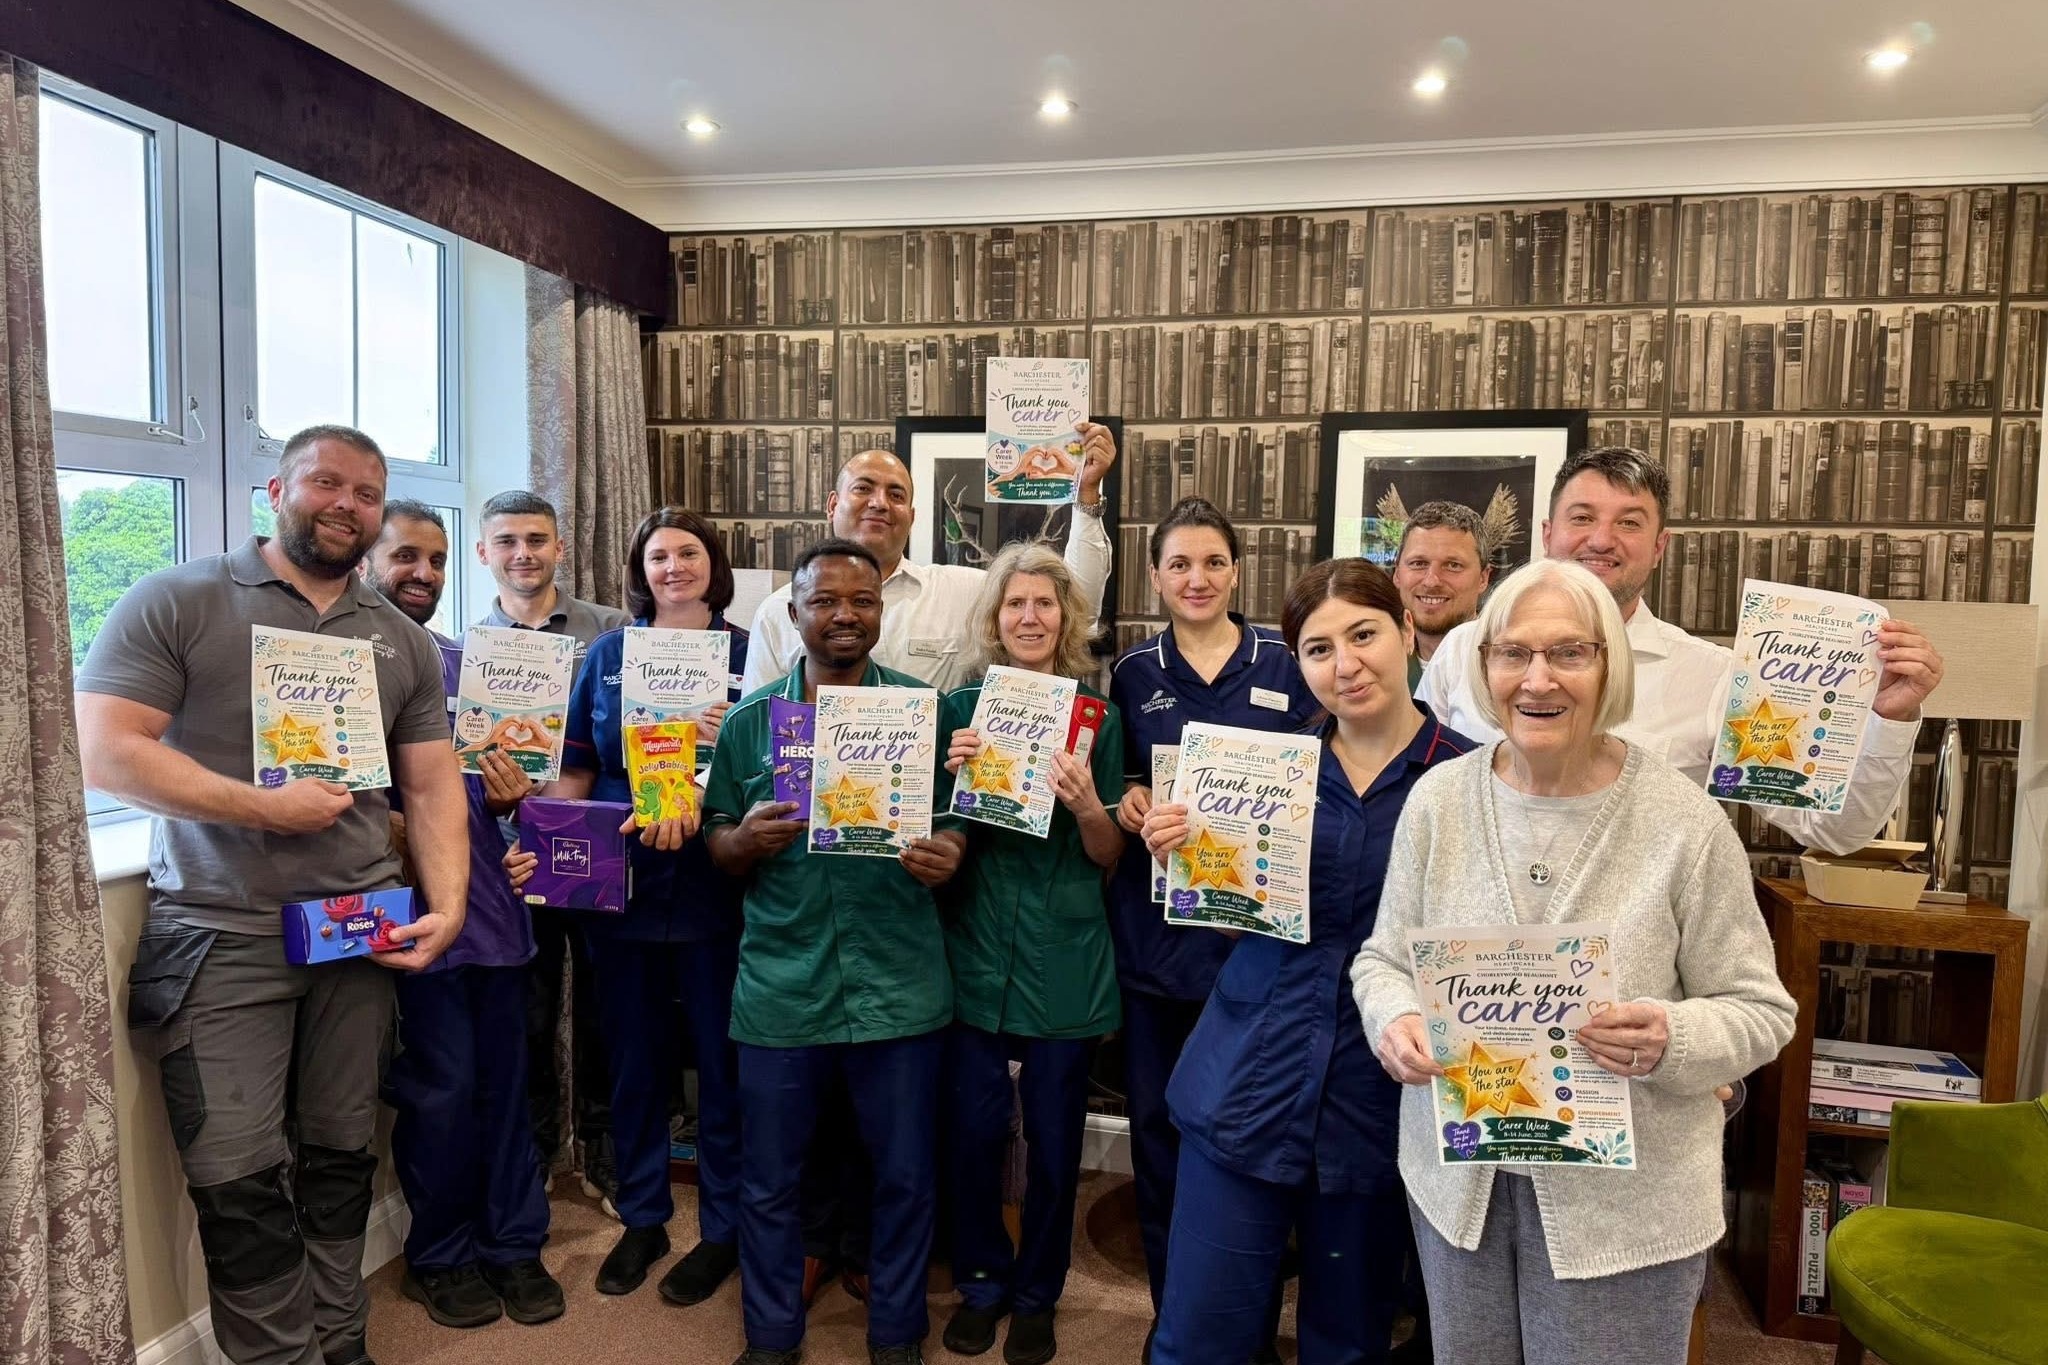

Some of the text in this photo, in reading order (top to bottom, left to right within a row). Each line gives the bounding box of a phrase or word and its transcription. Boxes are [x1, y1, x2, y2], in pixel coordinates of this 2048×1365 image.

[1013, 371, 1062, 379] BARCHESTER
[1001, 394, 1070, 413] Thank you
[1012, 410, 1064, 423] carer
[1017, 488, 1038, 497] Thank
[1792, 613, 1853, 629] BARCHESTER
[493, 640, 545, 651] BARCHESTER
[651, 641, 701, 650] BARCHESTER
[1753, 630, 1866, 667] Thank you
[292, 650, 339, 661] BARCHESTER
[265, 663, 320, 686] Thank
[326, 675, 358, 691] you
[477, 661, 552, 682] Thank you
[637, 662, 709, 681] Thank you
[1760, 657, 1856, 687] carer
[487, 678, 545, 693] carer
[648, 678, 702, 691] carer
[276, 683, 354, 702] carer
[1010, 686, 1050, 699] BARCHESTER
[986, 697, 1058, 727] Thank you
[986, 716, 1053, 740] carer
[1749, 720, 1787, 734] You are
[280, 729, 298, 740] You
[828, 722, 920, 747] Thank you
[1750, 732, 1787, 743] the star
[285, 738, 313, 747] the star
[642, 738, 682, 753] Maynards
[780, 745, 816, 759] HERO
[837, 742, 915, 762] carer
[1223, 751, 1277, 765] BARCHESTER
[299, 765, 334, 773] Carer Week
[980, 761, 993, 771] You
[980, 768, 991, 777] the
[1756, 768, 1795, 781] Carer Week
[1192, 767, 1296, 802] Thank you
[835, 791, 852, 803] You
[985, 796, 1015, 807] Carer Week
[839, 800, 867, 810] the star
[1198, 791, 1287, 821] carer
[848, 827, 882, 836] Carer Week
[553, 848, 588, 867] Milk Tray
[1196, 847, 1214, 859] You
[1199, 858, 1230, 869] the star
[1211, 892, 1250, 906] Carer Week
[346, 919, 375, 933] Roses
[1475, 952, 1555, 962] BARCHESTER
[1436, 974, 1588, 1005] Thank you
[1457, 999, 1580, 1024] carer
[1468, 1066, 1515, 1082] You are
[1474, 1076, 1518, 1093] the star
[1452, 1127, 1471, 1136] Thank
[1497, 1119, 1551, 1131] Carer Week
[1453, 1135, 1469, 1143] you for
[1460, 1142, 1469, 1150] you
[1487, 1145, 1497, 1153] You
[1499, 1152, 1528, 1162] Thank
[1809, 1210, 1821, 1237] 1000
[1807, 1252, 1820, 1294] PUZZLE
